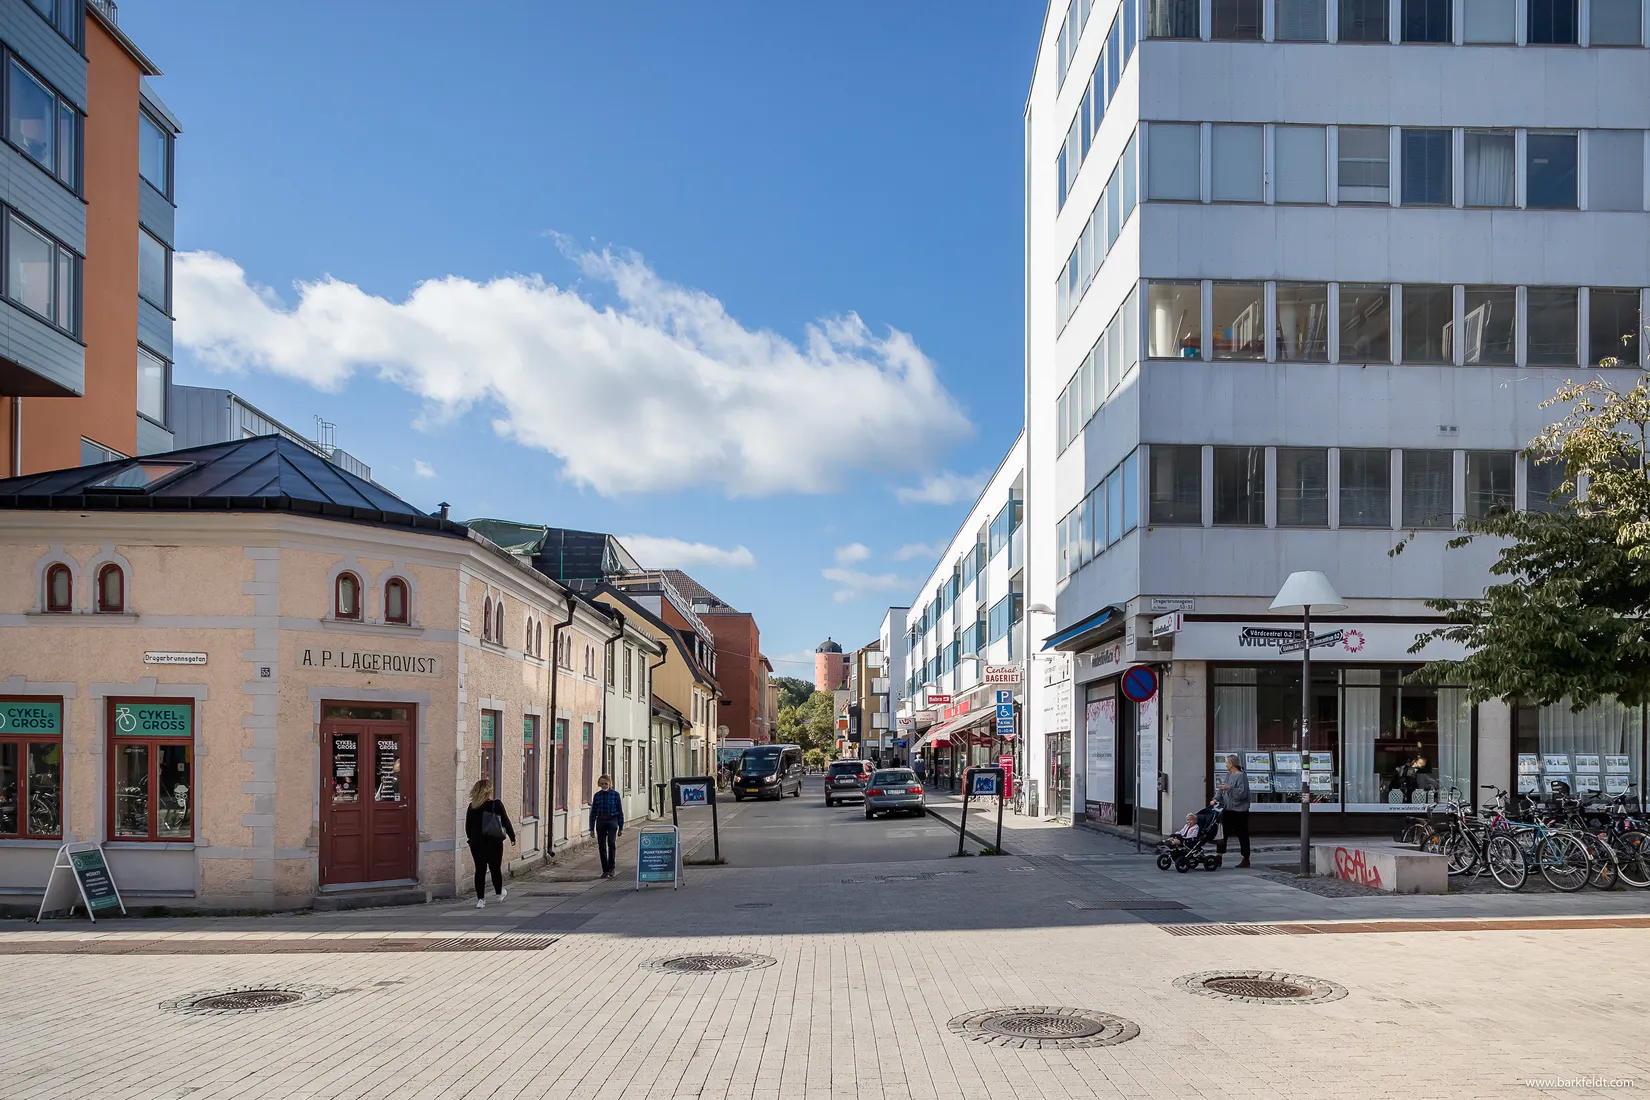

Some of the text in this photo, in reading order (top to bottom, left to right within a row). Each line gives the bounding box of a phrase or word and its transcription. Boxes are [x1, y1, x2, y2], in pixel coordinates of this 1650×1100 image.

[145, 654, 206, 663] Dragarbrunnsgatan
[340, 651, 437, 673] LAGERQVIST
[261, 668, 270, 677] 55
[985, 674, 1019, 682] BAGERIET
[8, 708, 47, 718] CYKEL
[138, 710, 179, 720] CYKEL
[12, 718, 55, 728] GROSS
[142, 721, 186, 730] GROSS
